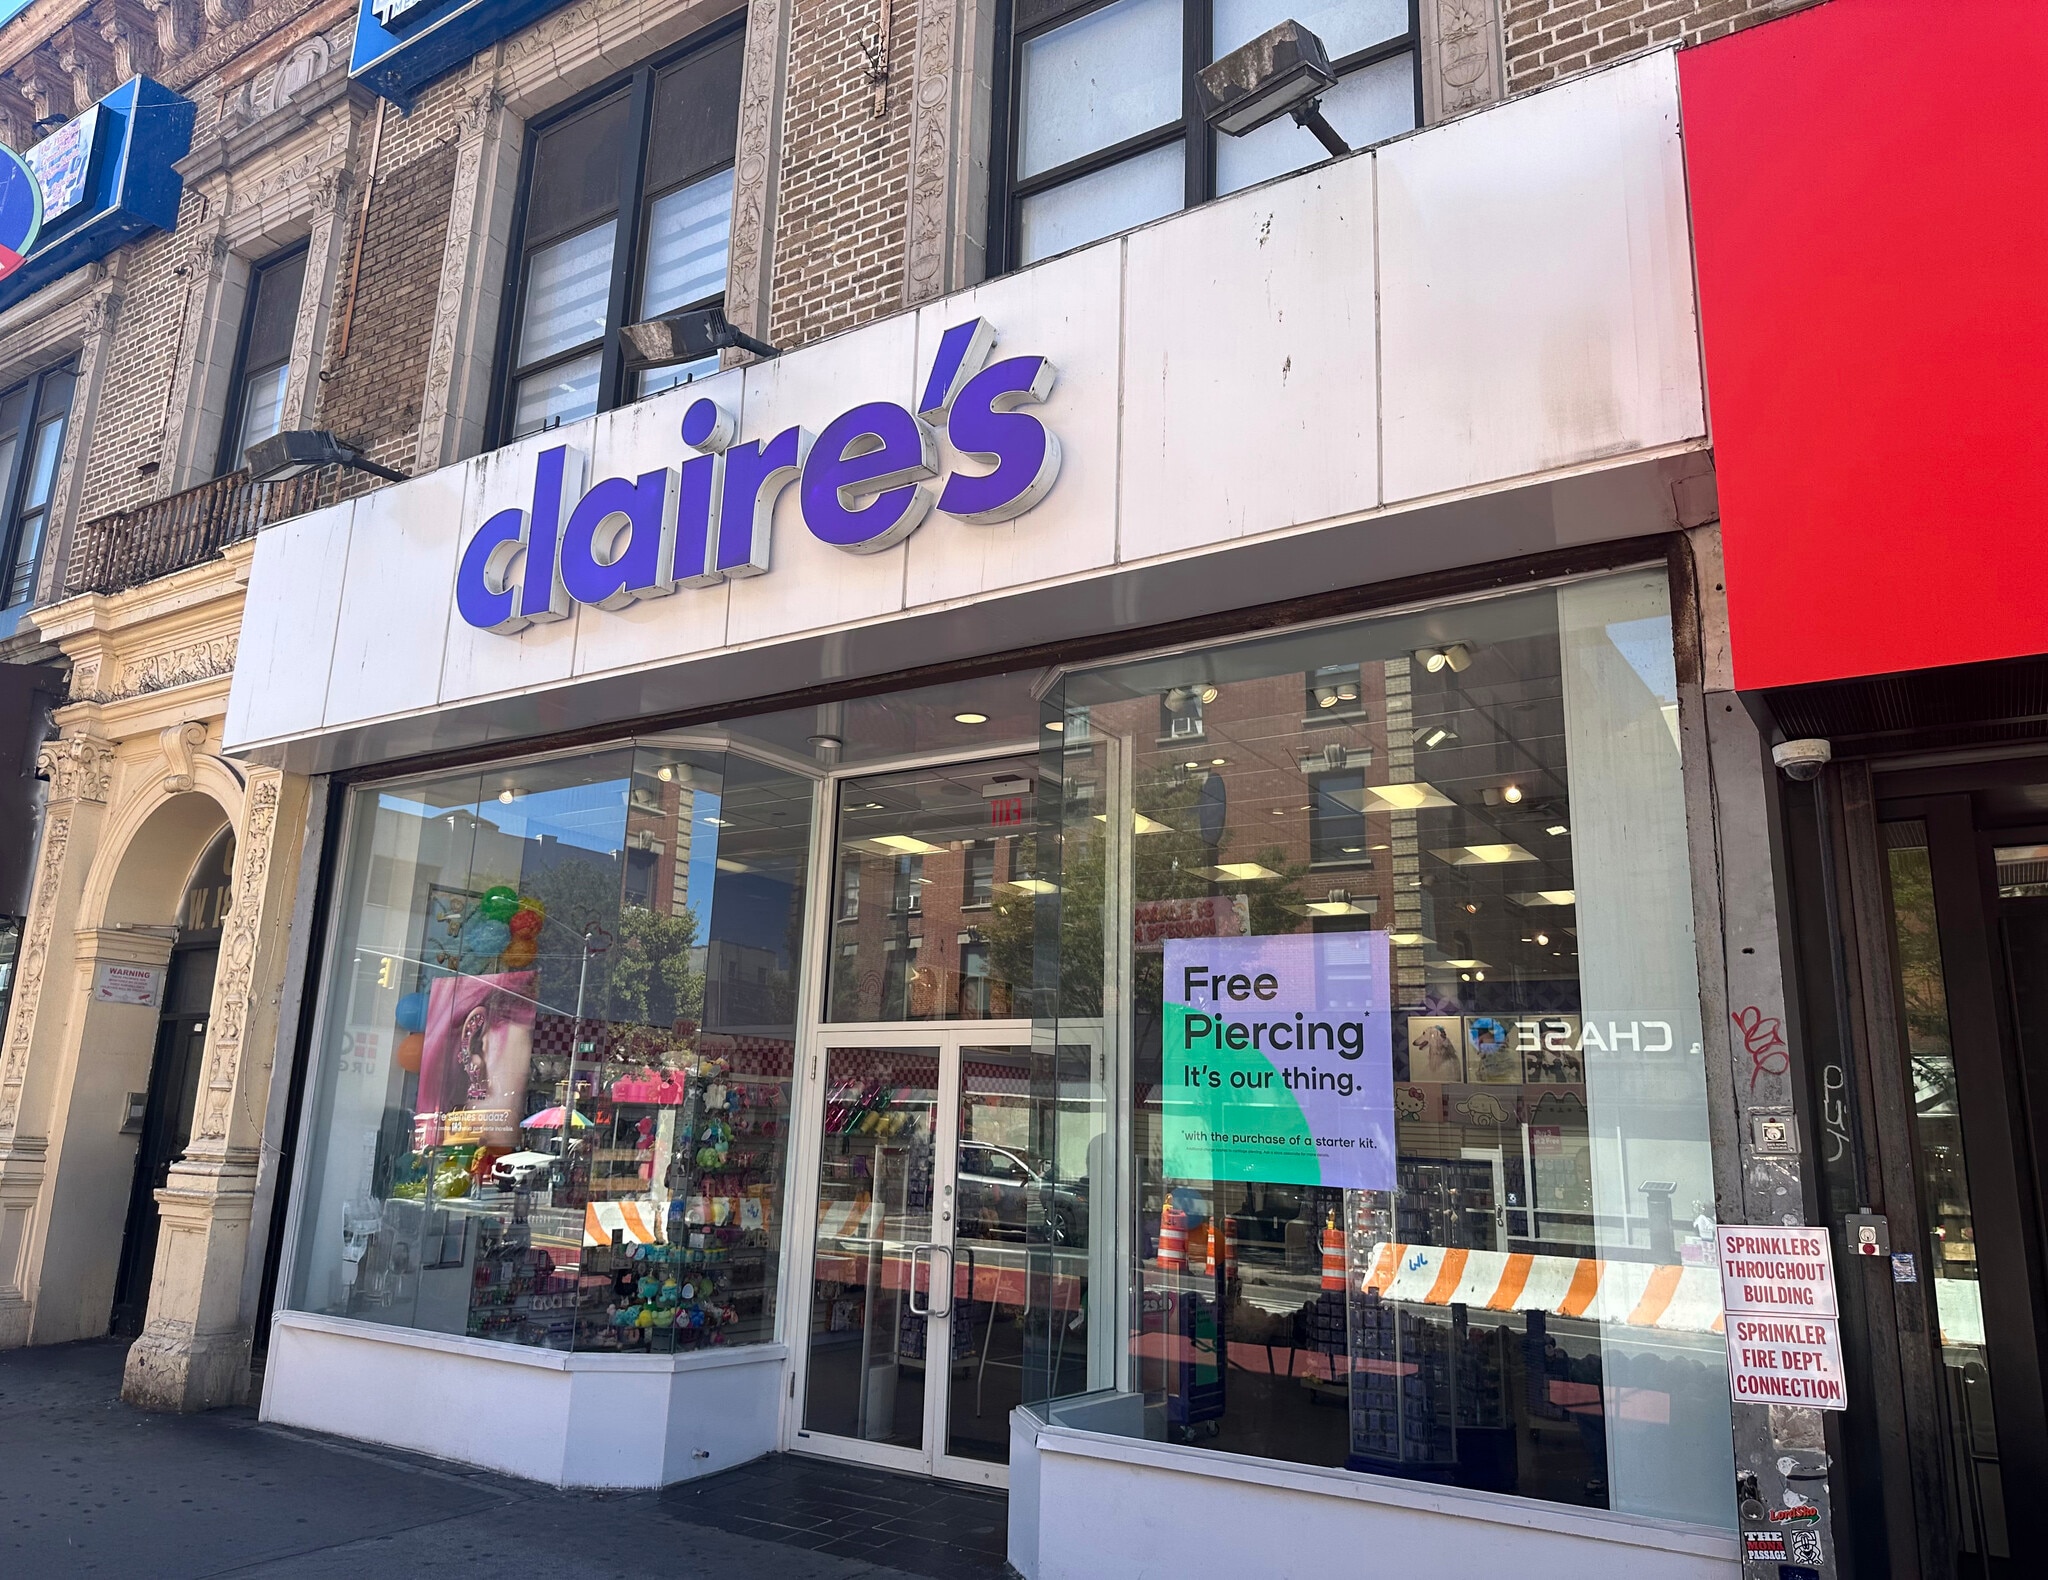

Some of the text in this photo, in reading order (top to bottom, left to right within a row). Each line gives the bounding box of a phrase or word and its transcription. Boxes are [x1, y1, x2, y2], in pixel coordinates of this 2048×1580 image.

[456, 317, 1060, 635] claire's
[1146, 919, 1217, 940] SESSION
[109, 967, 151, 979] WARNING
[1184, 966, 1278, 1001] Free
[1184, 1065, 1362, 1096] It's our thing.
[478, 1111, 509, 1122] audaz?
[1210, 1131, 1229, 1142] the
[1232, 1132, 1286, 1146] purchase
[1289, 1134, 1301, 1146] of
[1303, 1137, 1312, 1146] a
[1316, 1136, 1355, 1148] starter
[1359, 1137, 1378, 1149] kit.
[1726, 1236, 1821, 1256] SPRINKLERS
[1725, 1260, 1826, 1281] THROUGHOUT
[1743, 1285, 1814, 1305] BUILDING
[1736, 1322, 1827, 1345] SPRINKLER
[1742, 1348, 1828, 1372] FIRE DEPT.
[1736, 1374, 1841, 1400] CONNECTION
[1744, 1532, 1783, 1541] THE
[1747, 1541, 1784, 1550] MONA
[1748, 1550, 1787, 1560] PASSAGE
